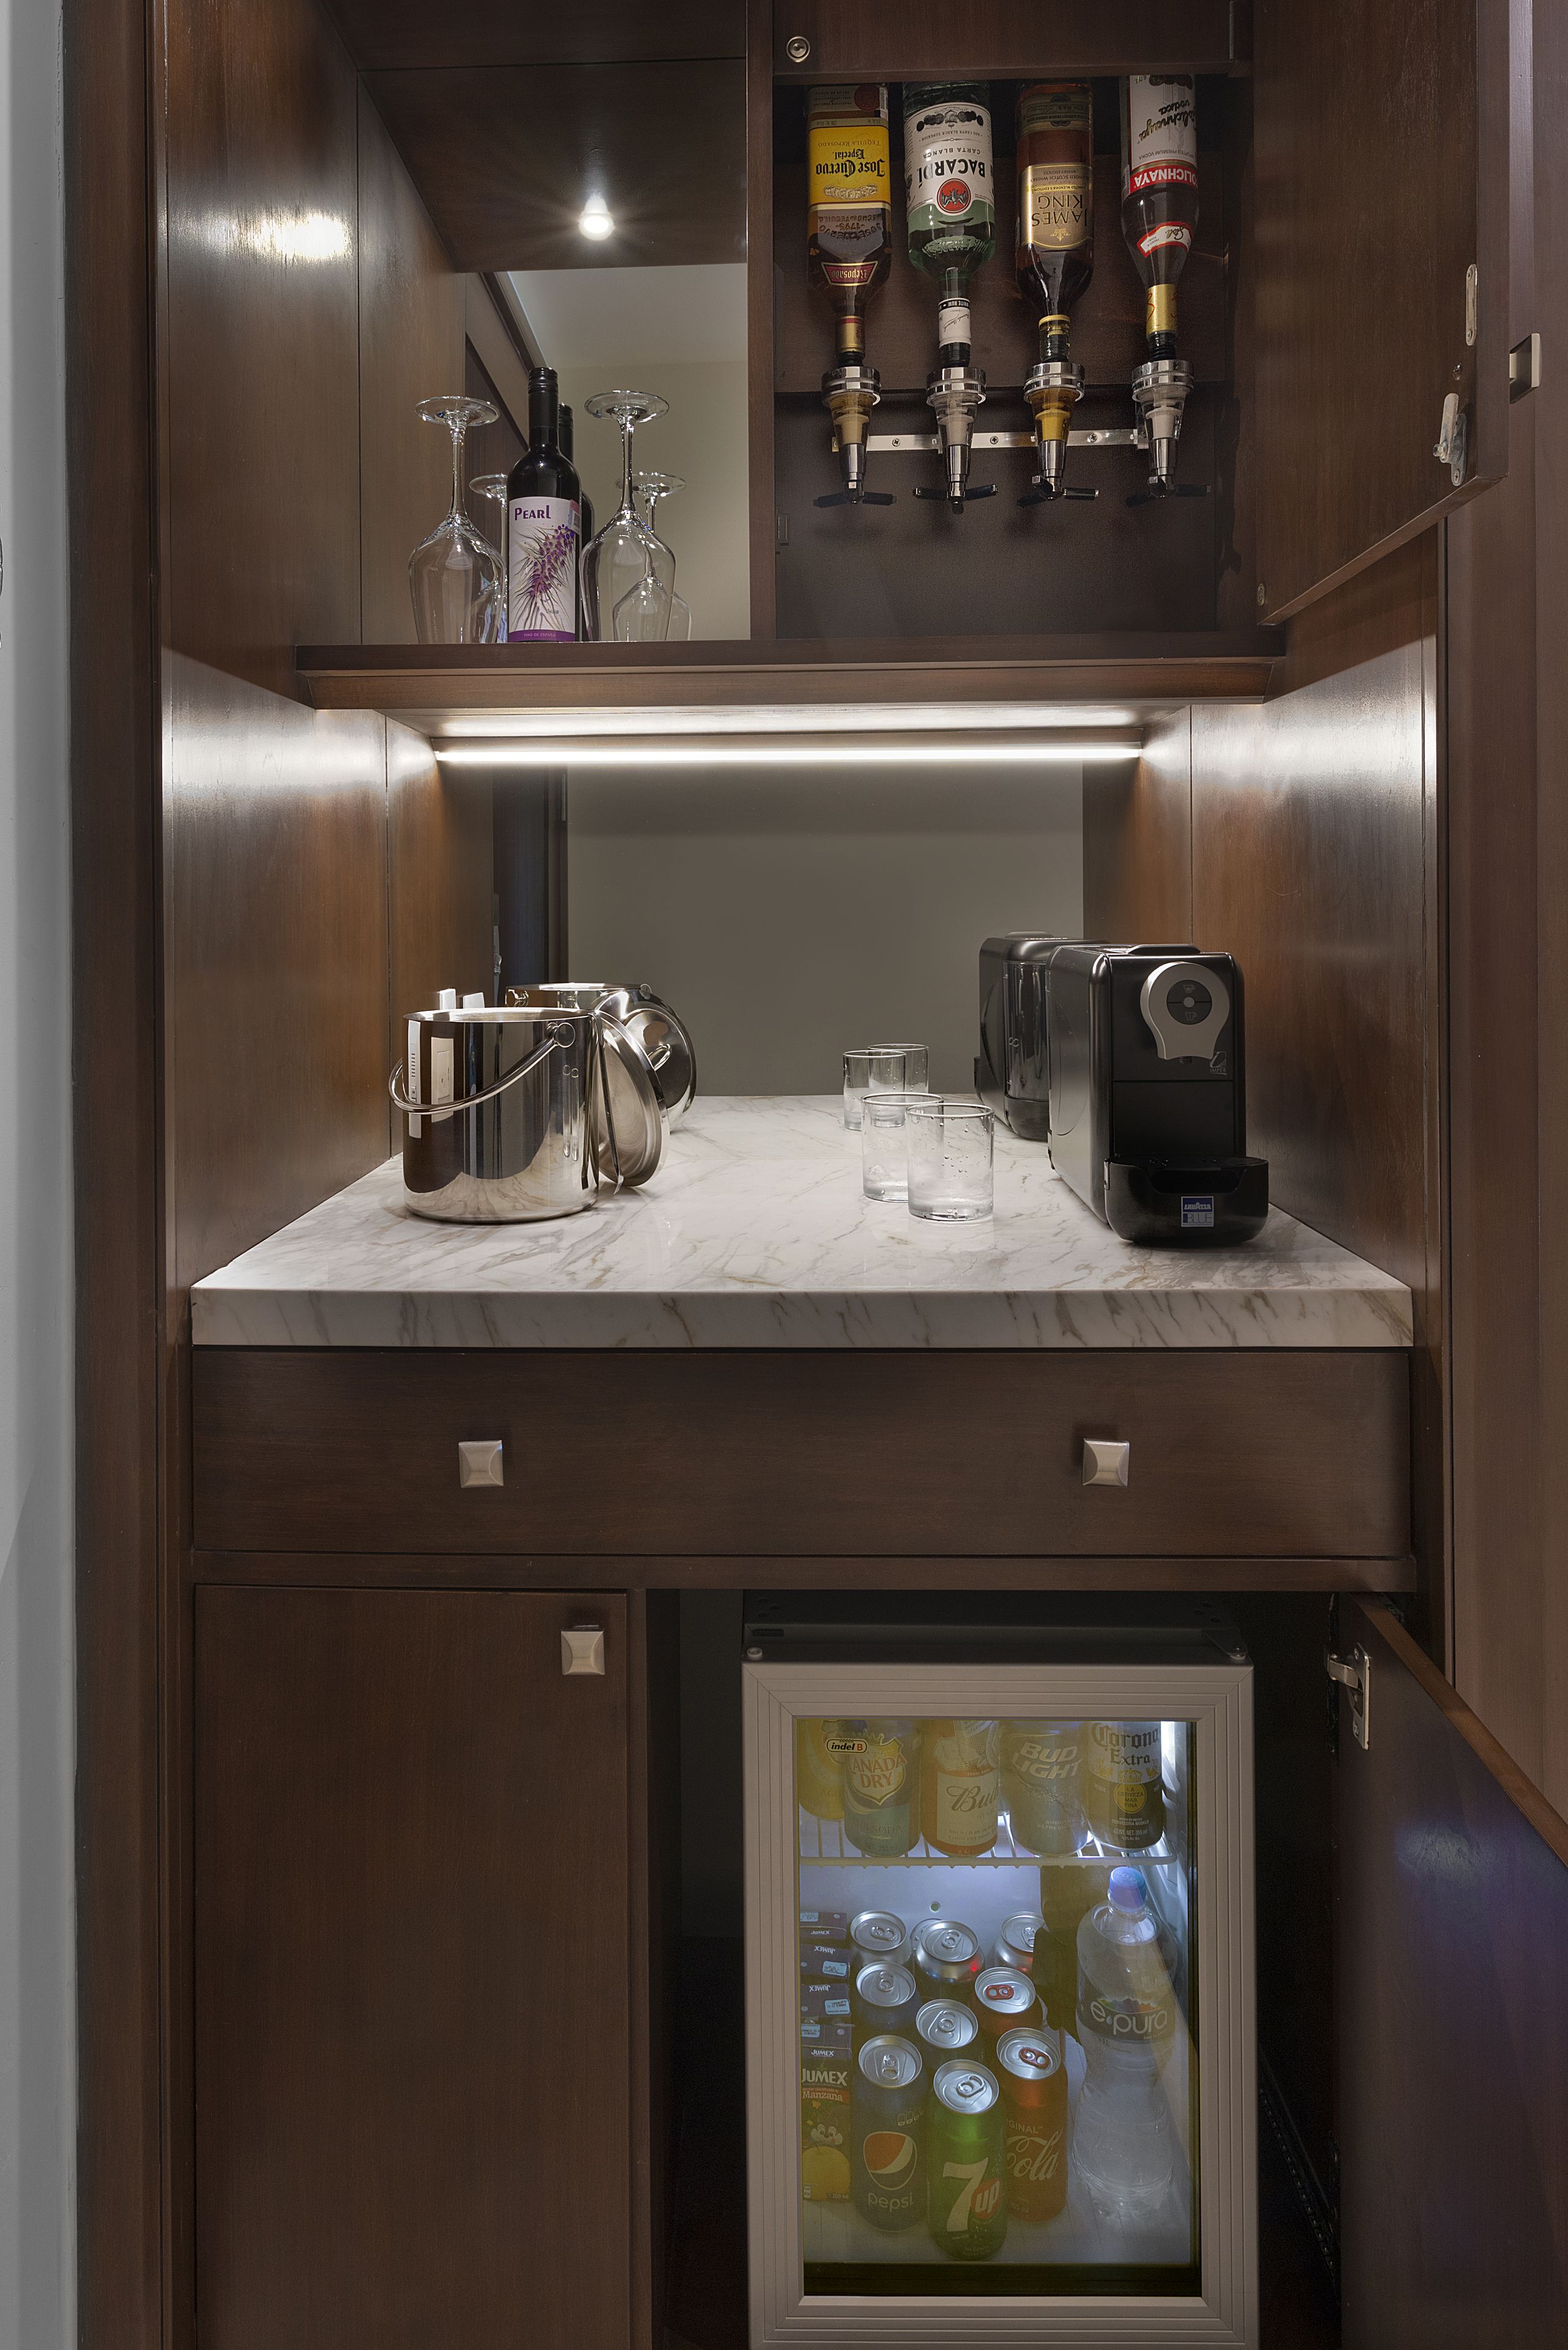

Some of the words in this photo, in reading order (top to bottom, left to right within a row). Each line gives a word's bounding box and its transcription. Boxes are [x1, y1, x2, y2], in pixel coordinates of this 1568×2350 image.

[922, 132, 941, 141] SUPERIOR
[923, 148, 954, 159] BLANCA
[815, 160, 856, 178] Cuervo
[858, 159, 885, 177] Jose
[1134, 168, 1197, 187] OLICHNAYA
[1037, 195, 1083, 209] KING
[1031, 209, 1088, 227] JAMES
[831, 269, 867, 279] Reposado
[515, 505, 551, 520] PEARL
[1187, 1213, 1214, 1223] BLUE
[1091, 1723, 1159, 1751] Corona
[831, 1742, 855, 1751] indel
[1019, 1742, 1077, 1762] BUD
[1012, 1751, 1082, 1779] LIGHT
[1110, 1747, 1151, 1766] Extra
[860, 1772, 892, 1788] DRY
[814, 1945, 836, 1954] JUMEX
[802, 2068, 848, 2086] JUMEX
[802, 2091, 843, 2102] Manzana
[1007, 2119, 1039, 2133] GINAL
[868, 2191, 913, 2213] pepsi
[943, 2157, 988, 2232] 7
